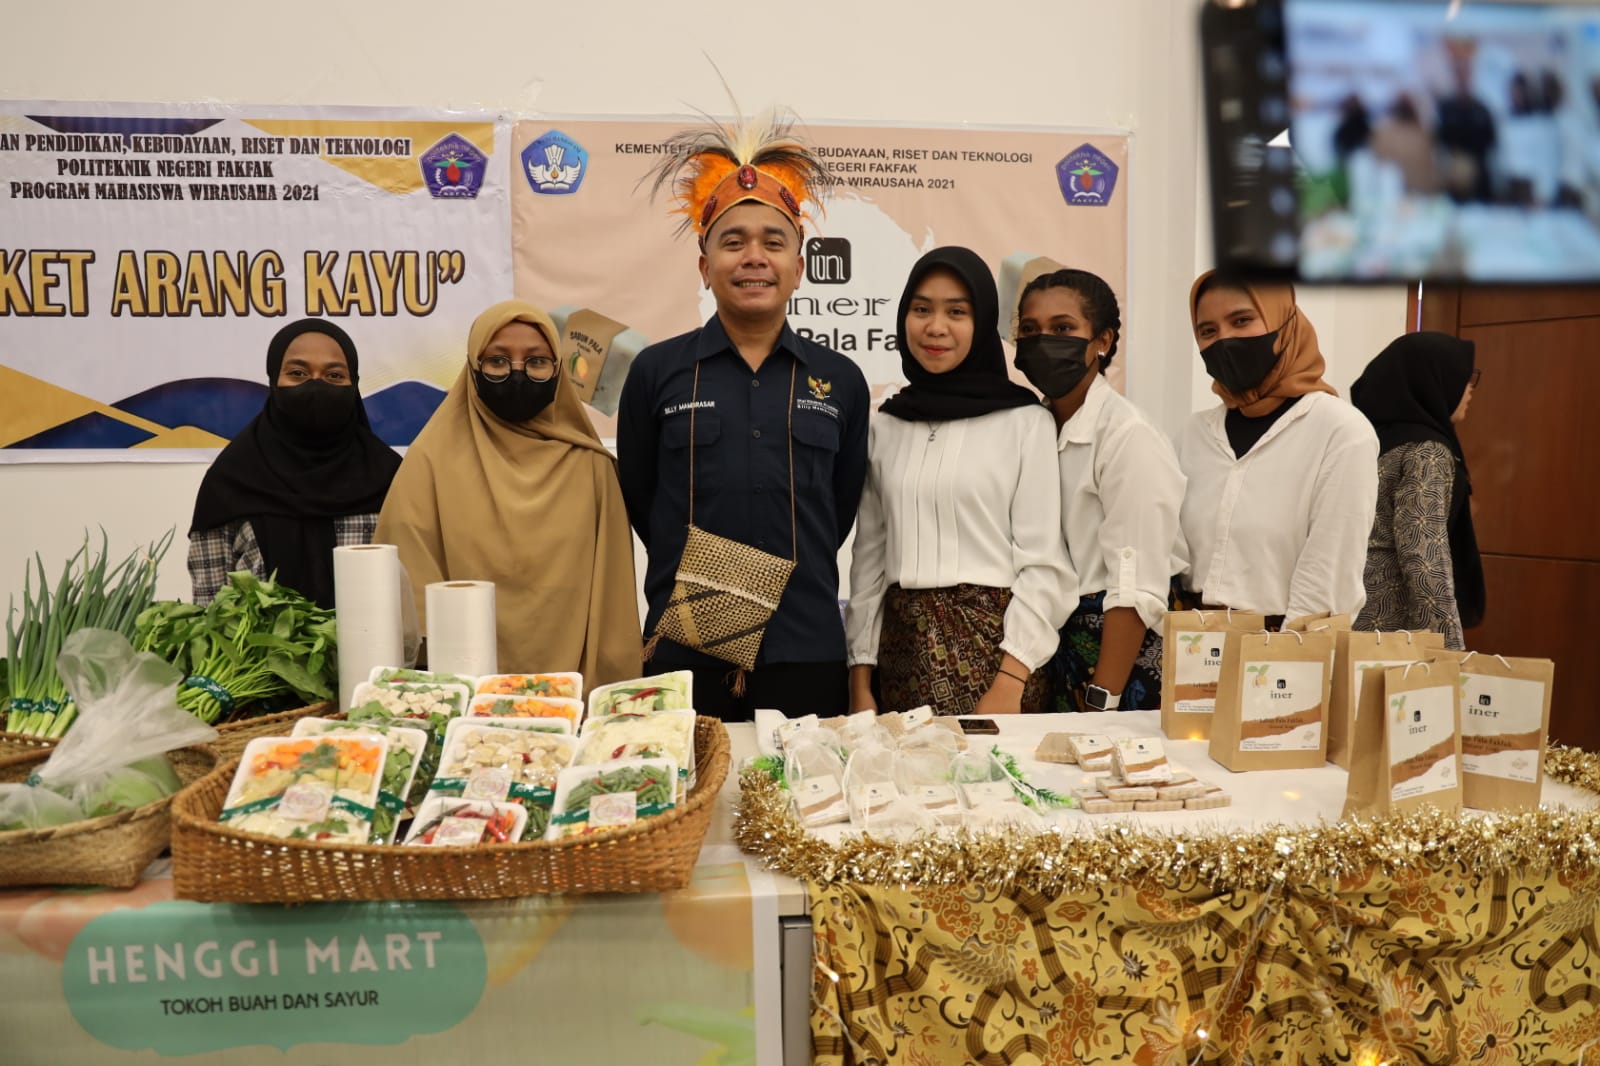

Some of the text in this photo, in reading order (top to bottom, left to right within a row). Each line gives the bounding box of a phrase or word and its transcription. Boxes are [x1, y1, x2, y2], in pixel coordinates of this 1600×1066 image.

[0, 134, 19, 151] AN
[25, 134, 128, 155] PENDIDIKAN,
[132, 135, 236, 155] KEBUDAYAAN,
[241, 137, 285, 154] RISET
[289, 137, 320, 154] DAN
[325, 138, 411, 156] TEKNOLOGI
[809, 146, 889, 160] EBUDAYAAN,
[892, 149, 928, 160] RISET
[931, 150, 958, 161] DAN
[961, 151, 1033, 163] TEKNOLOGI
[56, 158, 274, 178] POLITEKNIK NEGERI FAKFAK
[868, 163, 917, 174] FAKFAK
[10, 181, 319, 201] PROGRAM MAHASISWA WIRAUSAHA 2021
[848, 177, 924, 189] WIRAUSAHA
[927, 179, 955, 190] 2021
[0, 249, 95, 317] KET
[111, 250, 287, 317] ARANG
[787, 297, 891, 316] ner
[867, 328, 900, 351] Fa
[1270, 691, 1293, 699] iner
[1469, 705, 1500, 718] iner
[87, 931, 443, 985] HENGGI MART
[160, 990, 379, 1015] TOKOH BUAH DAN SAYUR
